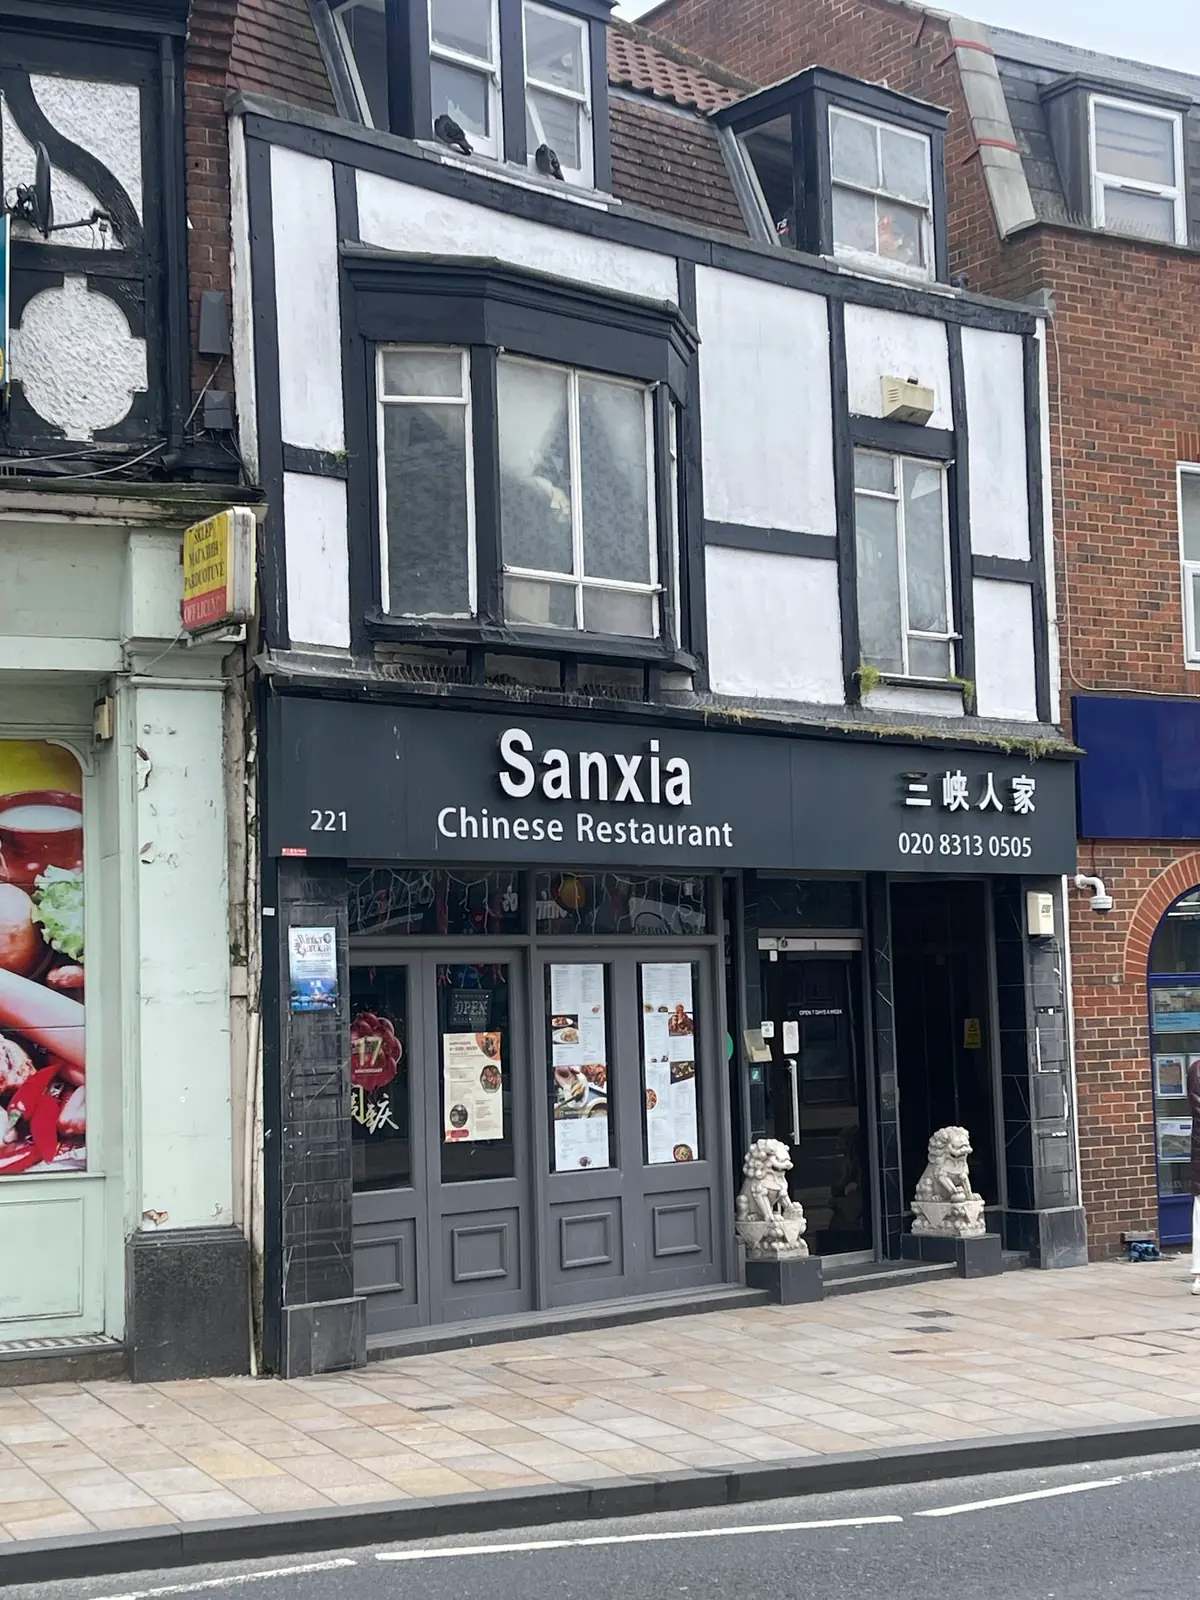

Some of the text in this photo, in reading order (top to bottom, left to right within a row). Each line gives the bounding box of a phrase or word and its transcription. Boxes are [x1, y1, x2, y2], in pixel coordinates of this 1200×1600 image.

[499, 728, 692, 806] Sanxia
[901, 769, 1036, 814] 三峡人家
[310, 809, 348, 832] 221
[437, 806, 733, 848] Chinese Restaurant
[898, 832, 1032, 858] 020 8313 0505
[455, 1000, 489, 1016] OPEN
[355, 1036, 383, 1067] 17
